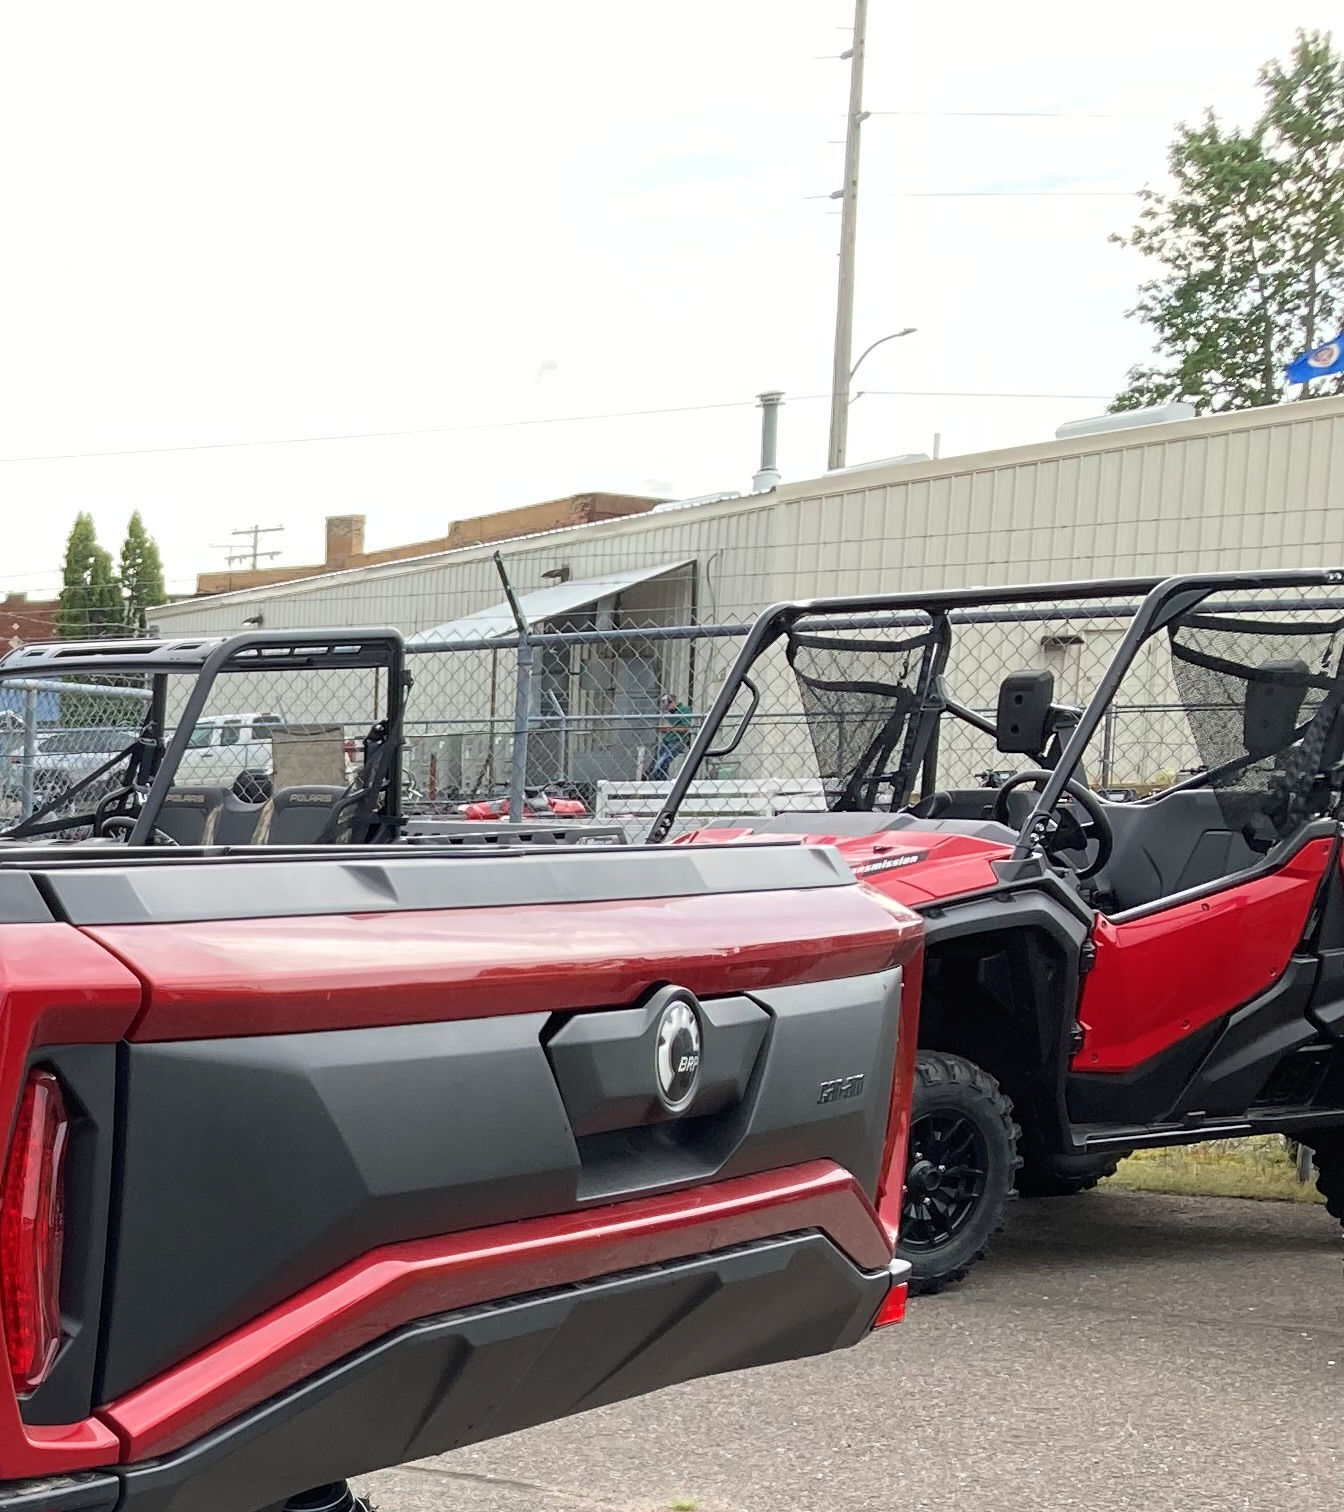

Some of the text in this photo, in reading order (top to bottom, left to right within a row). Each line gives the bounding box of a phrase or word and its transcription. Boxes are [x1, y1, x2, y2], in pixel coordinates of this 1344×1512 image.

[165, 794, 205, 803] POLARIS
[289, 793, 333, 803] POLARIS
[678, 1056, 699, 1073] BRP
